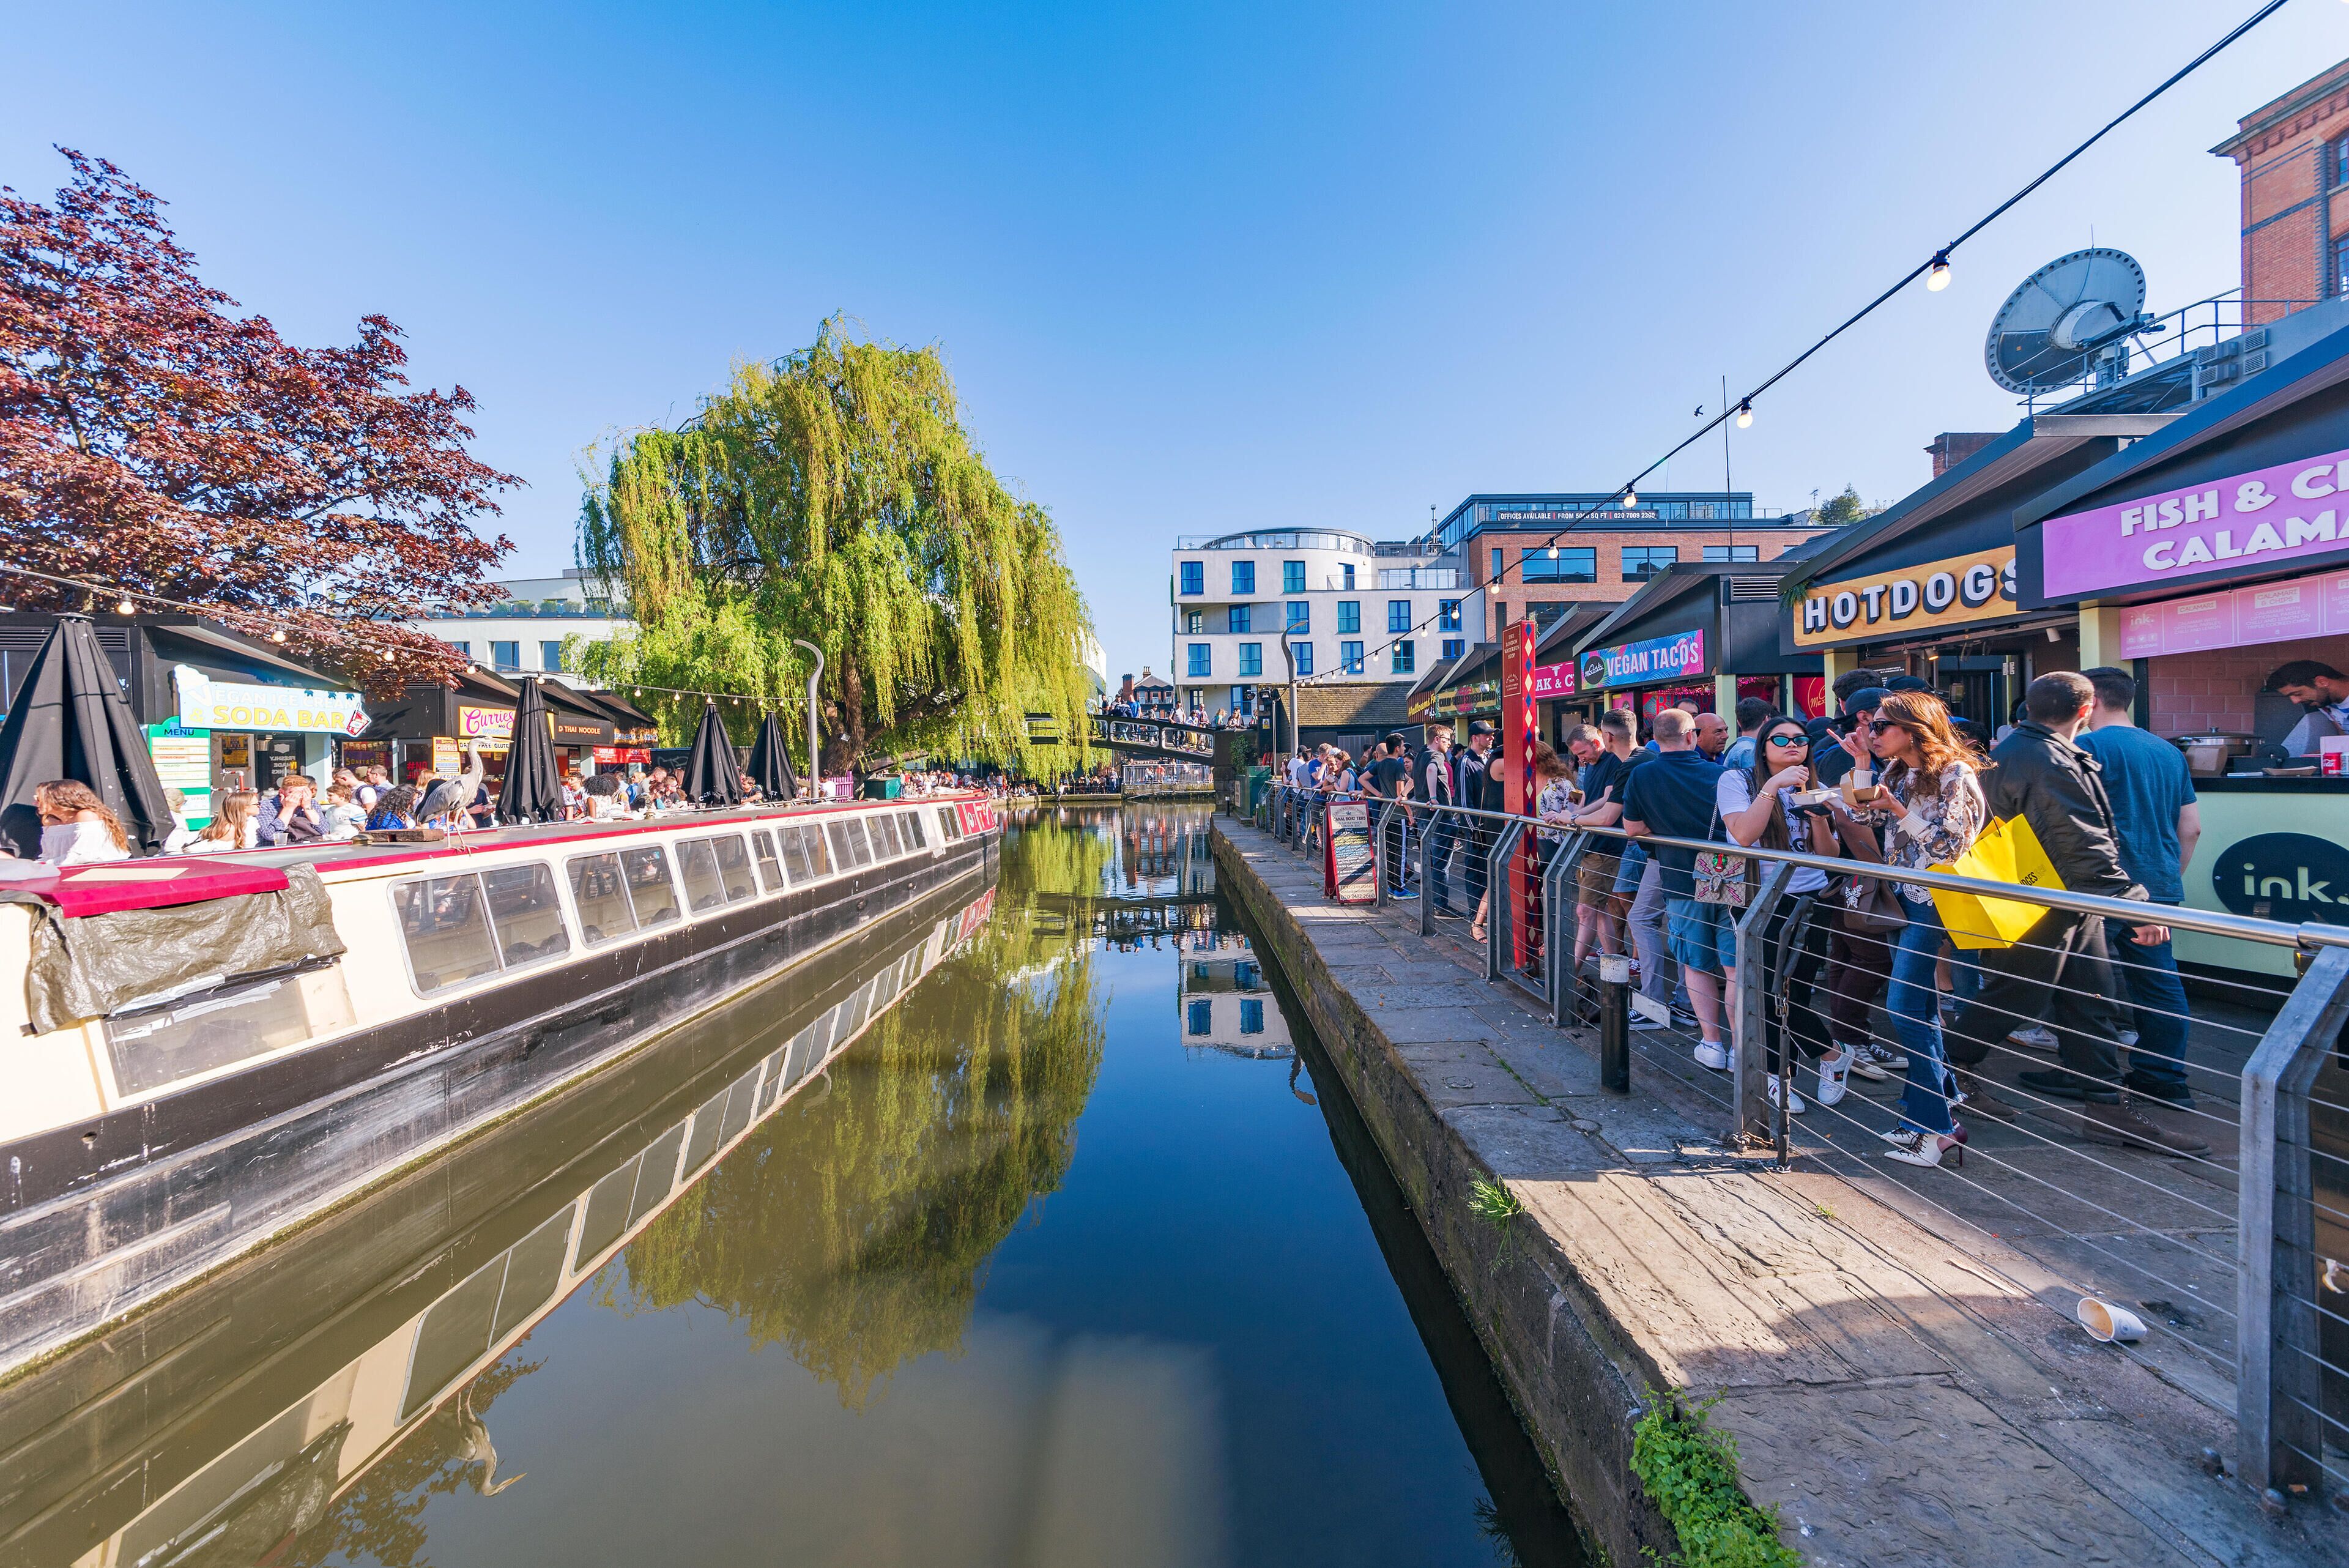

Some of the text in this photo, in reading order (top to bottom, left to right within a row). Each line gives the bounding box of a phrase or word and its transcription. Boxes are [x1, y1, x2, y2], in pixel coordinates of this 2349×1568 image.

[2121, 489, 2219, 537] FISH
[2234, 480, 2277, 513] &
[2257, 589, 2297, 600] CALAMARI
[2179, 602, 2215, 612] CALAMARI
[2130, 614, 2154, 626] ink.
[1589, 662, 1603, 672] Club
[1606, 642, 1699, 677] VEGAN TACOS
[185, 683, 268, 707] VEGAN
[271, 693, 299, 707] ICE
[1535, 677, 1553, 691] AK
[1554, 677, 1565, 689] &
[213, 705, 291, 727] SODA
[298, 710, 345, 729] BAR
[463, 709, 515, 734] Curries
[2243, 862, 2349, 905] ink.
